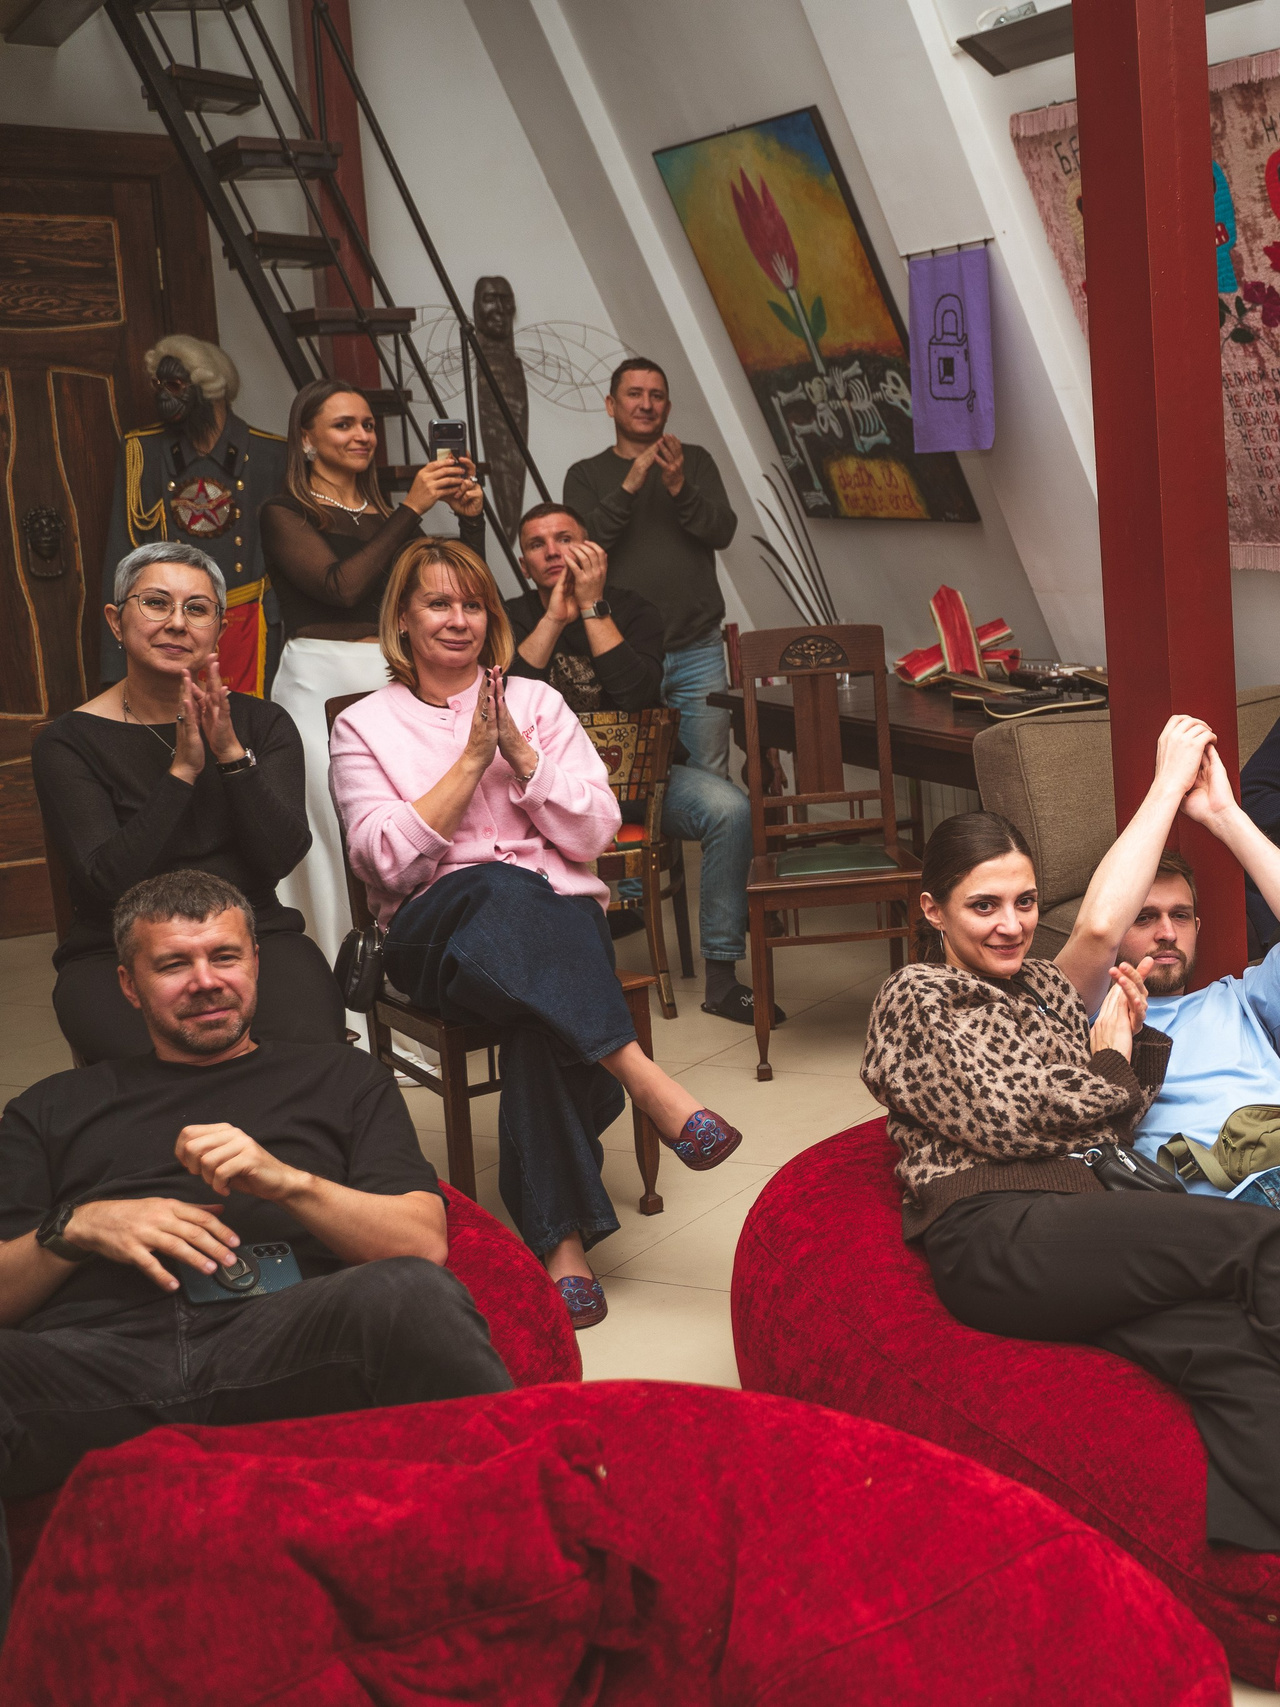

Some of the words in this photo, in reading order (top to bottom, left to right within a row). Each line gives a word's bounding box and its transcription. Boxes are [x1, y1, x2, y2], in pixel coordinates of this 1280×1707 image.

[1226, 393, 1242, 409] НЕ
[1232, 410, 1280, 427] СЛЕЗАМИ
[1239, 428, 1256, 444] НЕ
[1245, 446, 1274, 462] ТЕБЯ
[838, 460, 882, 491] death
[1256, 465, 1274, 480] НО
[889, 477, 922, 513] end
[1257, 484, 1268, 501] В
